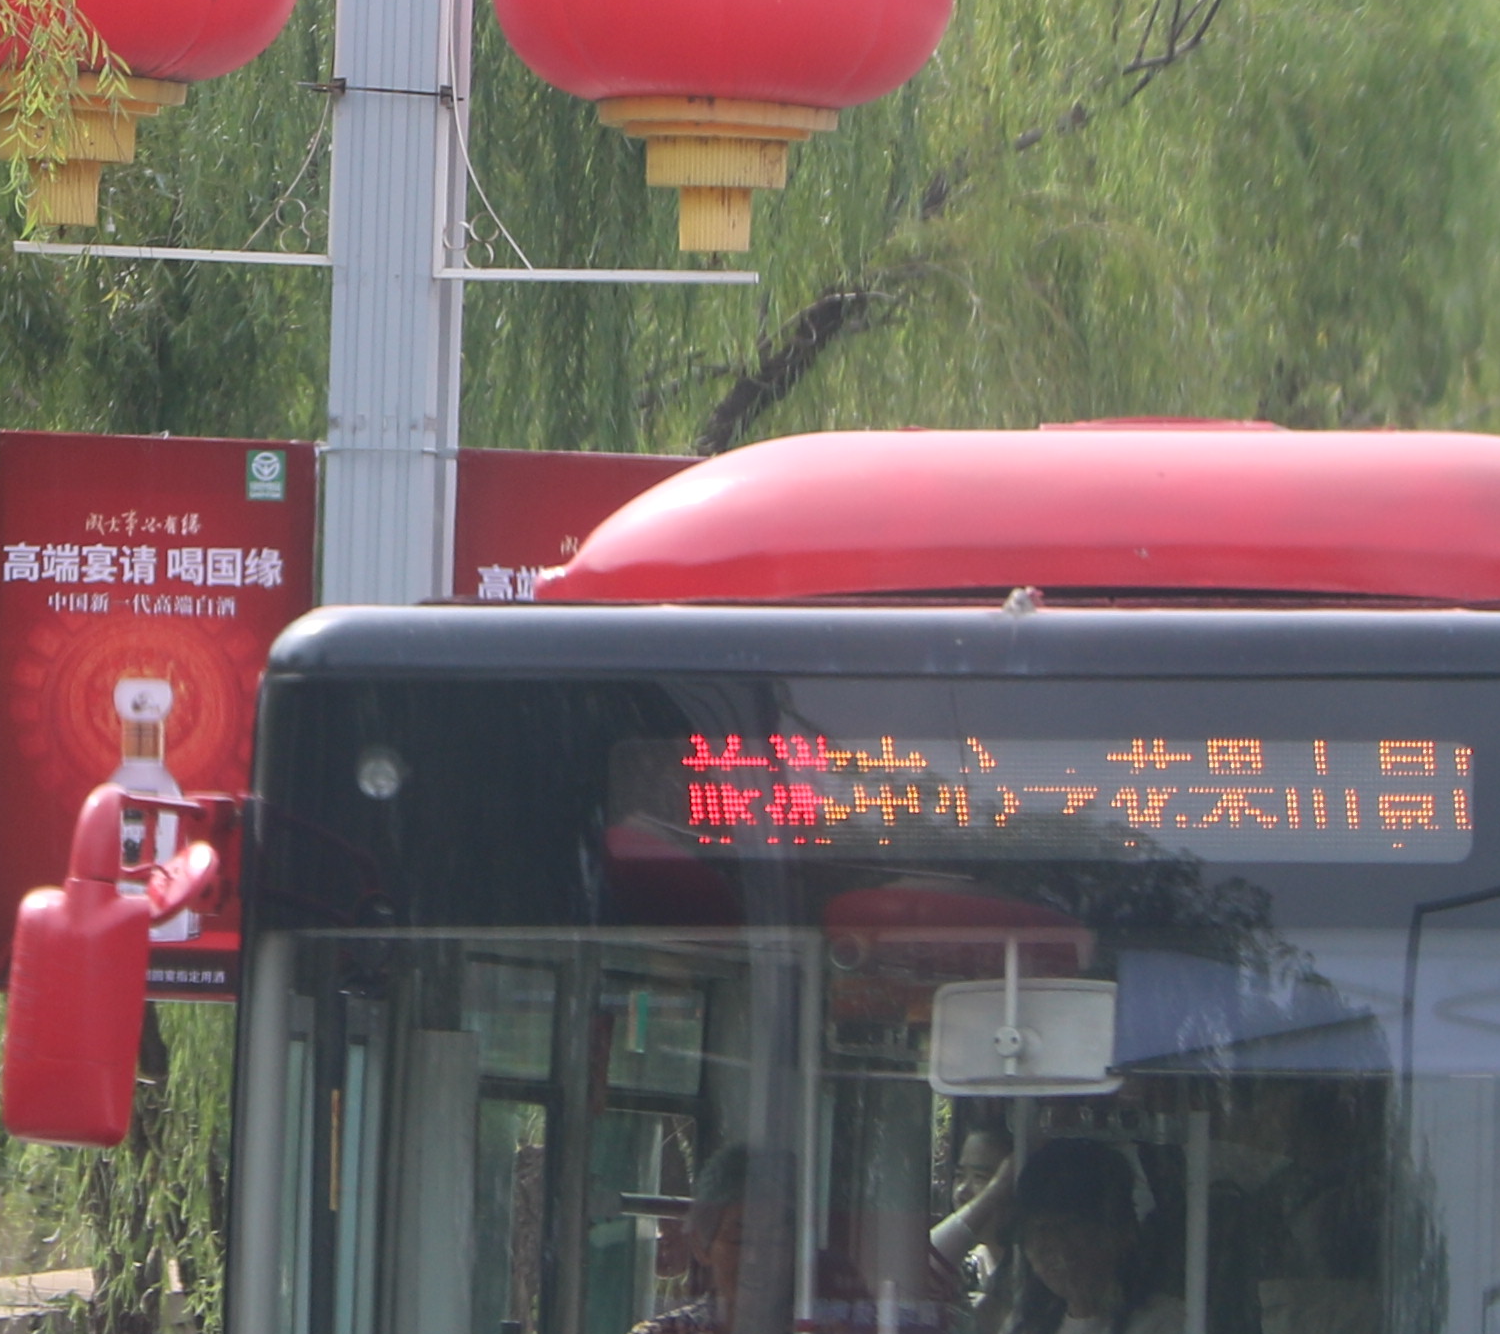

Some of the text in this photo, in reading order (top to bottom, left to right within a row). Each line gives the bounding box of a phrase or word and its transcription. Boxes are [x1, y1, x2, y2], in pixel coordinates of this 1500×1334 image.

[2, 543, 284, 589] 高端宴请 喝国缘
[47, 592, 236, 618] 中国新一代高端白酒
